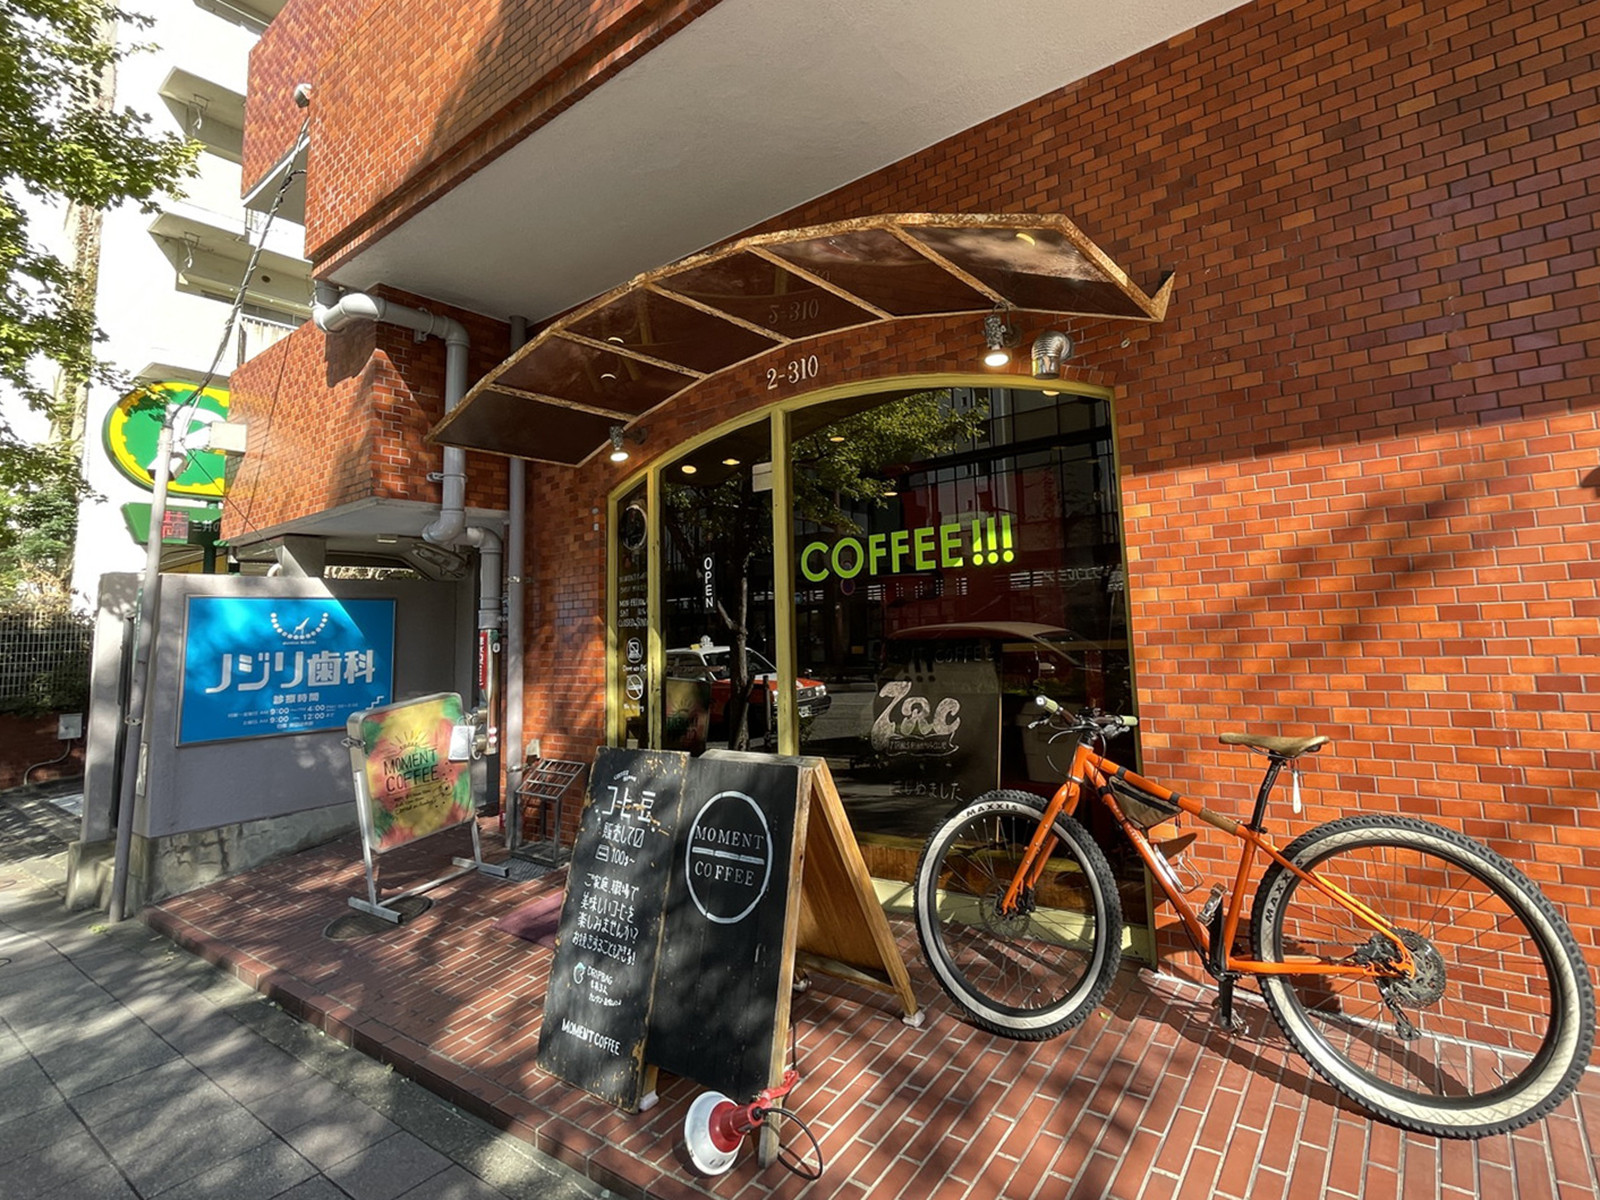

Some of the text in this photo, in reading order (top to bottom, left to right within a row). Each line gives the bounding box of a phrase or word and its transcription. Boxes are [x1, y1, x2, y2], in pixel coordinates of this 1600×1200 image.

[766, 354, 819, 390] 2-310
[703, 556, 714, 609] OPEN
[205, 649, 376, 694] ノジリ歯科
[270, 708, 289, 716] 9:00
[307, 704, 325, 712] 4:00
[273, 692, 319, 705] 診療時間
[303, 712, 325, 720] 12:00
[383, 747, 438, 775] MOMENT
[386, 764, 439, 792] COFFEE
[966, 803, 1018, 817] MAXXIS
[694, 825, 765, 850] MOMENT
[694, 860, 755, 886] COFFEE
[1265, 859, 1303, 924] MAXXS
[561, 1017, 621, 1056] MOMENT COFFEE
